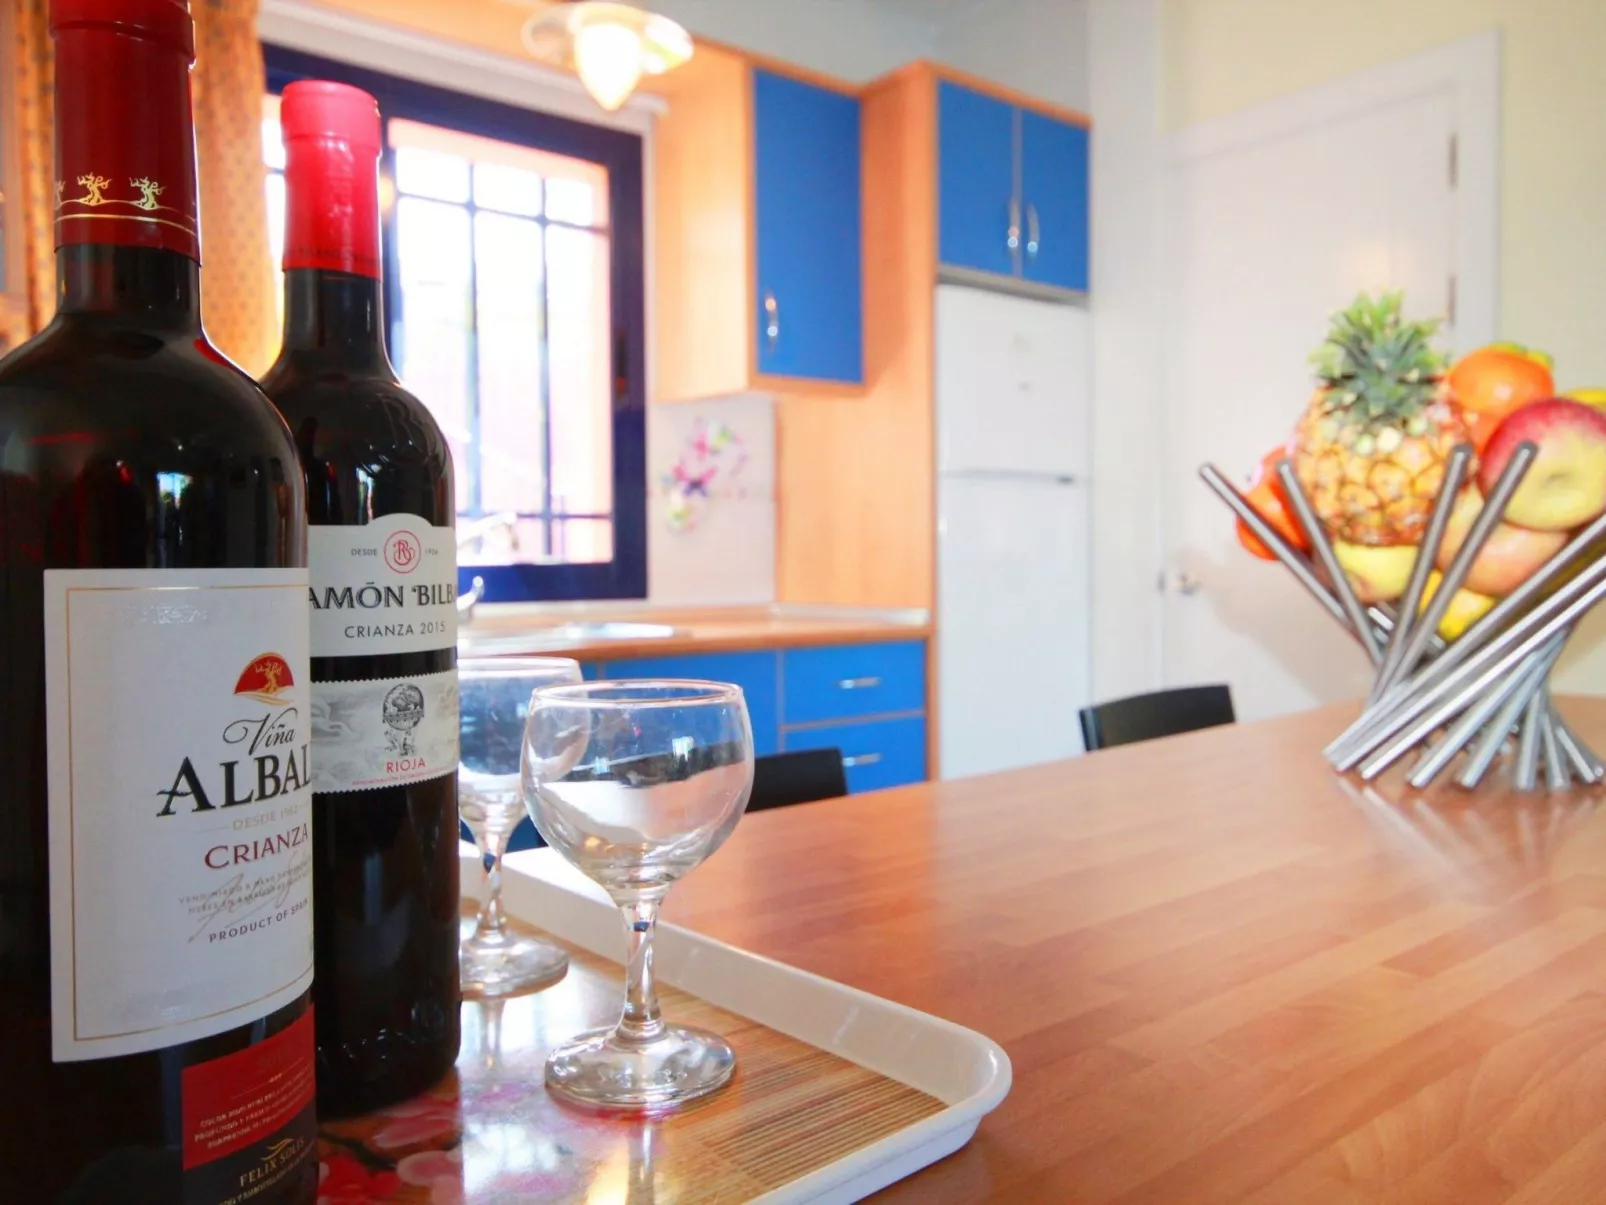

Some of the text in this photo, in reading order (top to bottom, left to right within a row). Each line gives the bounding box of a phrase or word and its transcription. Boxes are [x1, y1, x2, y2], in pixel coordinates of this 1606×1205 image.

[351, 548, 377, 556] DESDE
[411, 583, 457, 606] BILB
[344, 621, 446, 639] CRIANZA 2015
[222, 707, 298, 756] Viña
[386, 758, 426, 773] RIOJA
[233, 811, 276, 831] DESDE
[204, 823, 308, 869] CRIANZA
[209, 916, 272, 943] PRODUCT
[276, 910, 288, 922] OF
